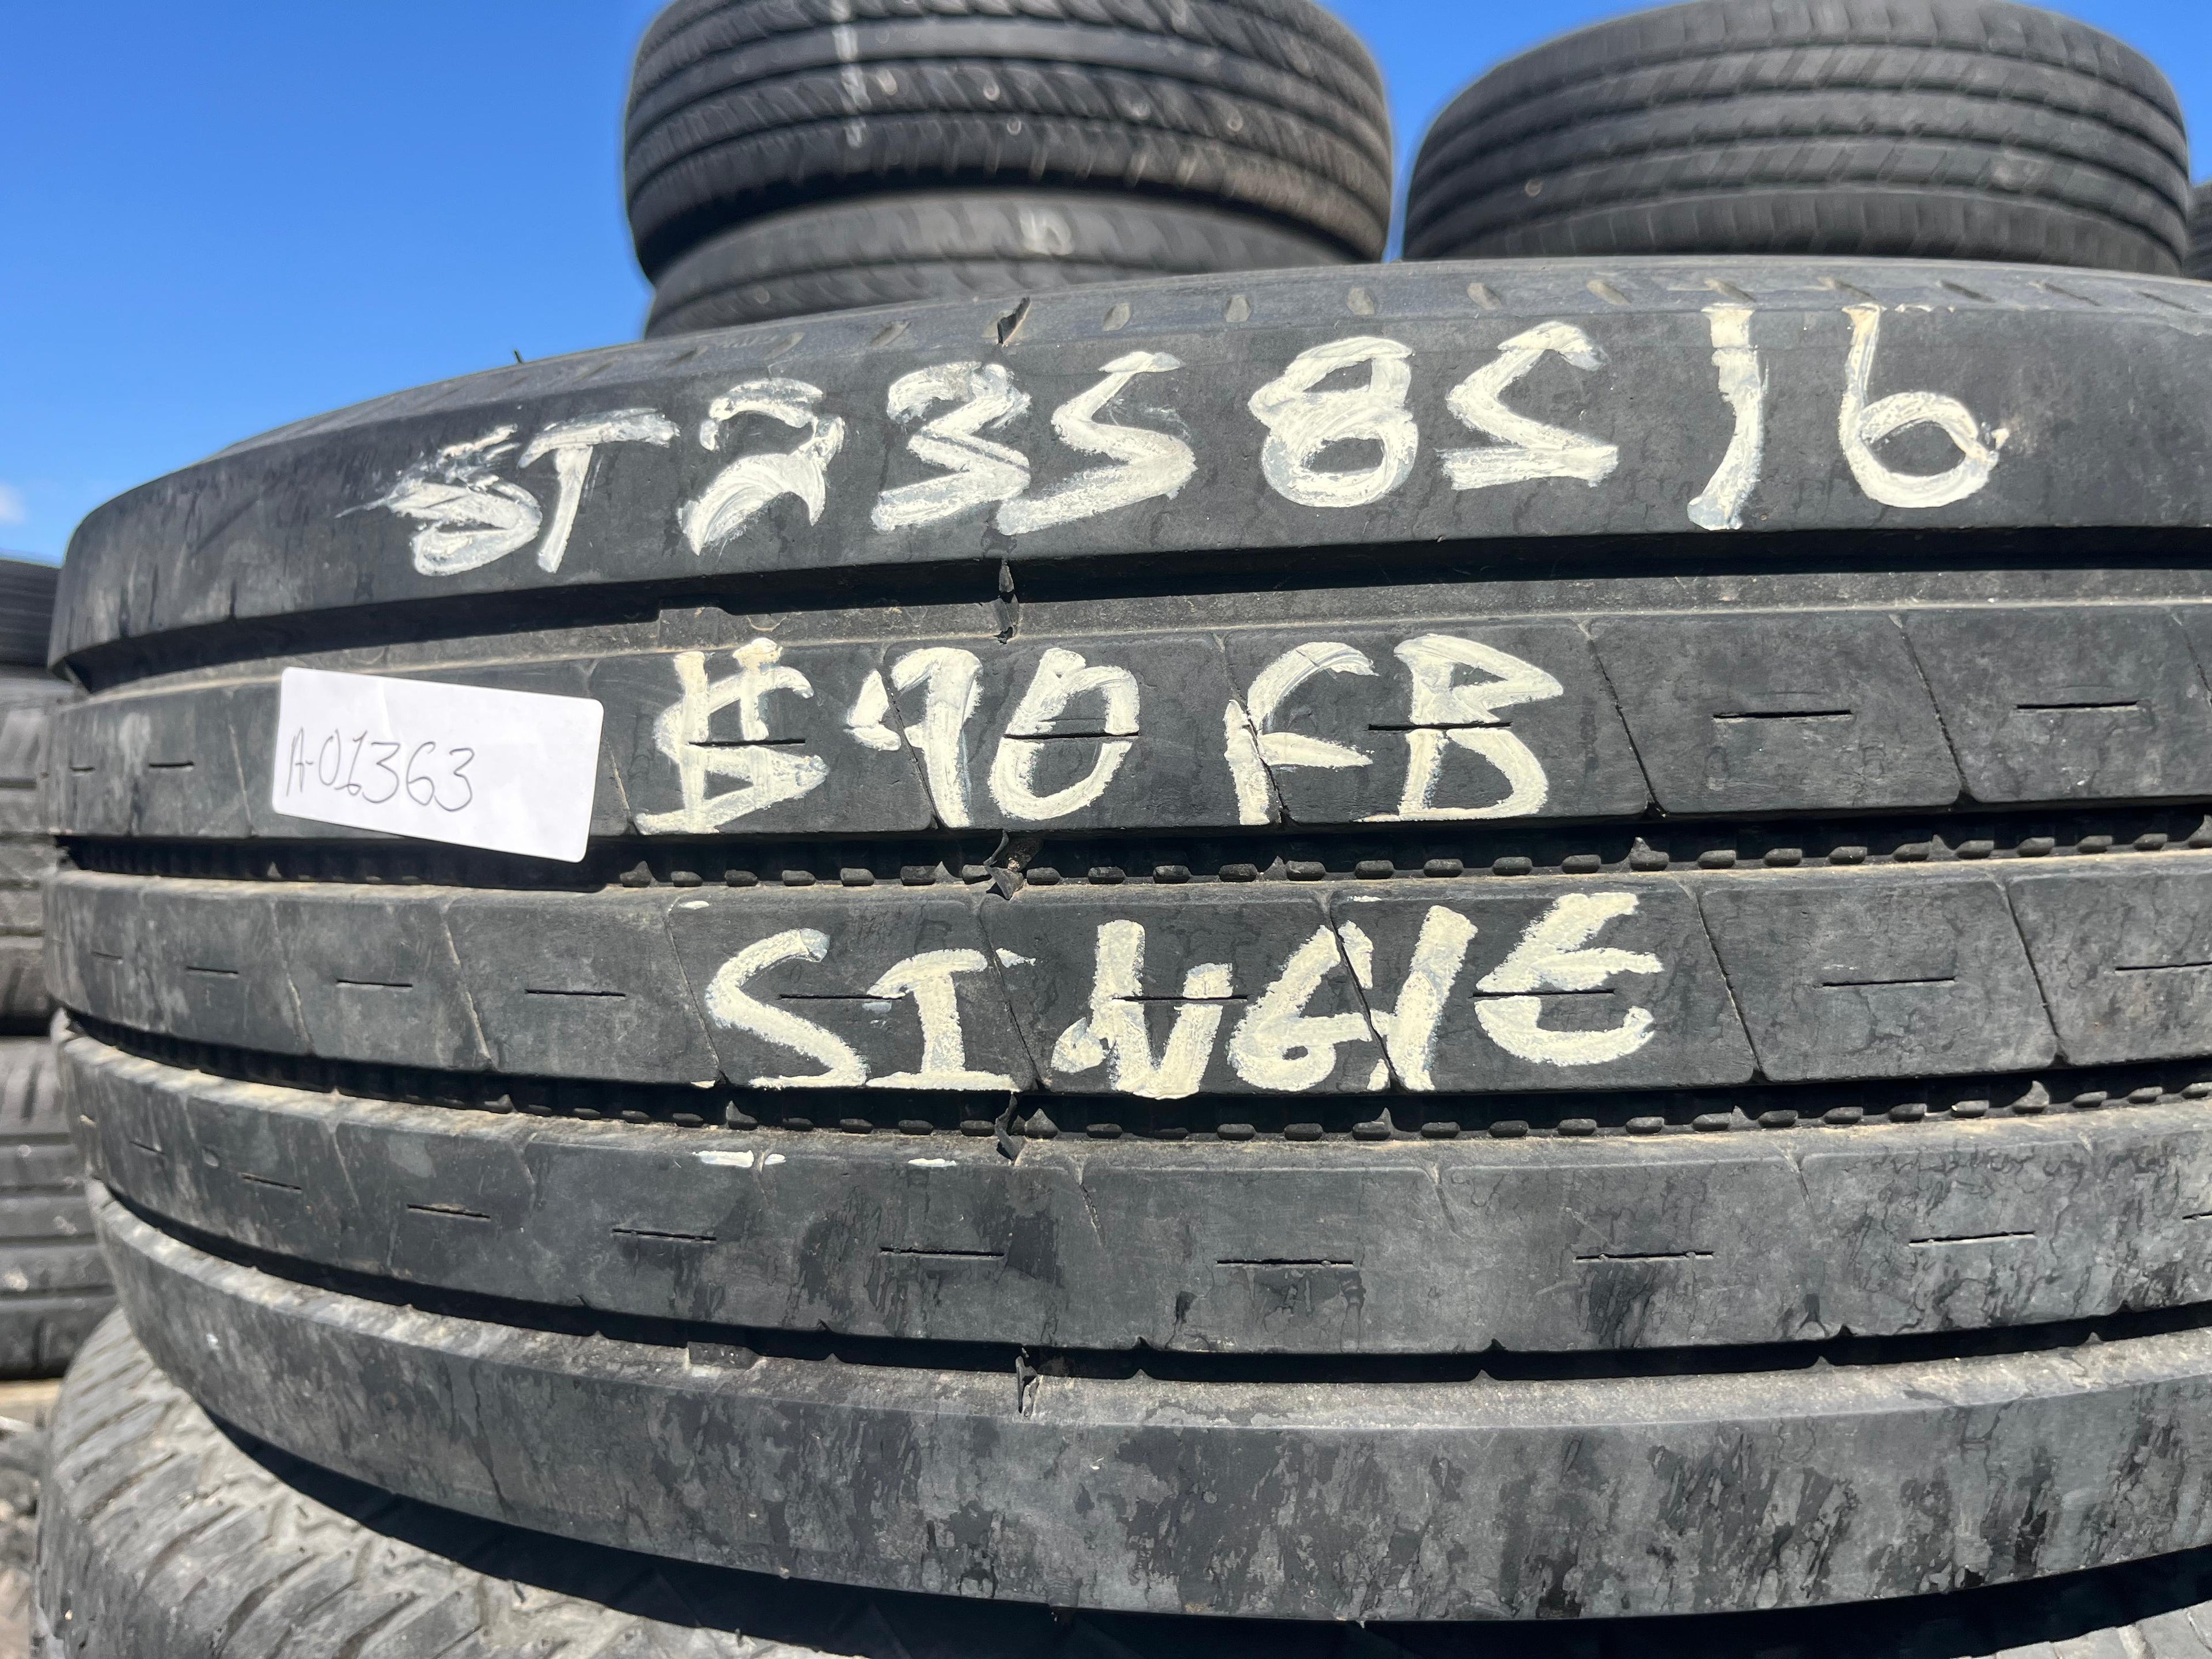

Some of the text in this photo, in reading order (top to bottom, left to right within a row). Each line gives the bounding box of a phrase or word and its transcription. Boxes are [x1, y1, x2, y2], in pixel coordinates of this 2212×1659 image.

[675, 350, 1197, 558] 235
[1248, 334, 1619, 508] 85
[1688, 302, 2009, 532] 16
[1225, 634, 1565, 826] FB
